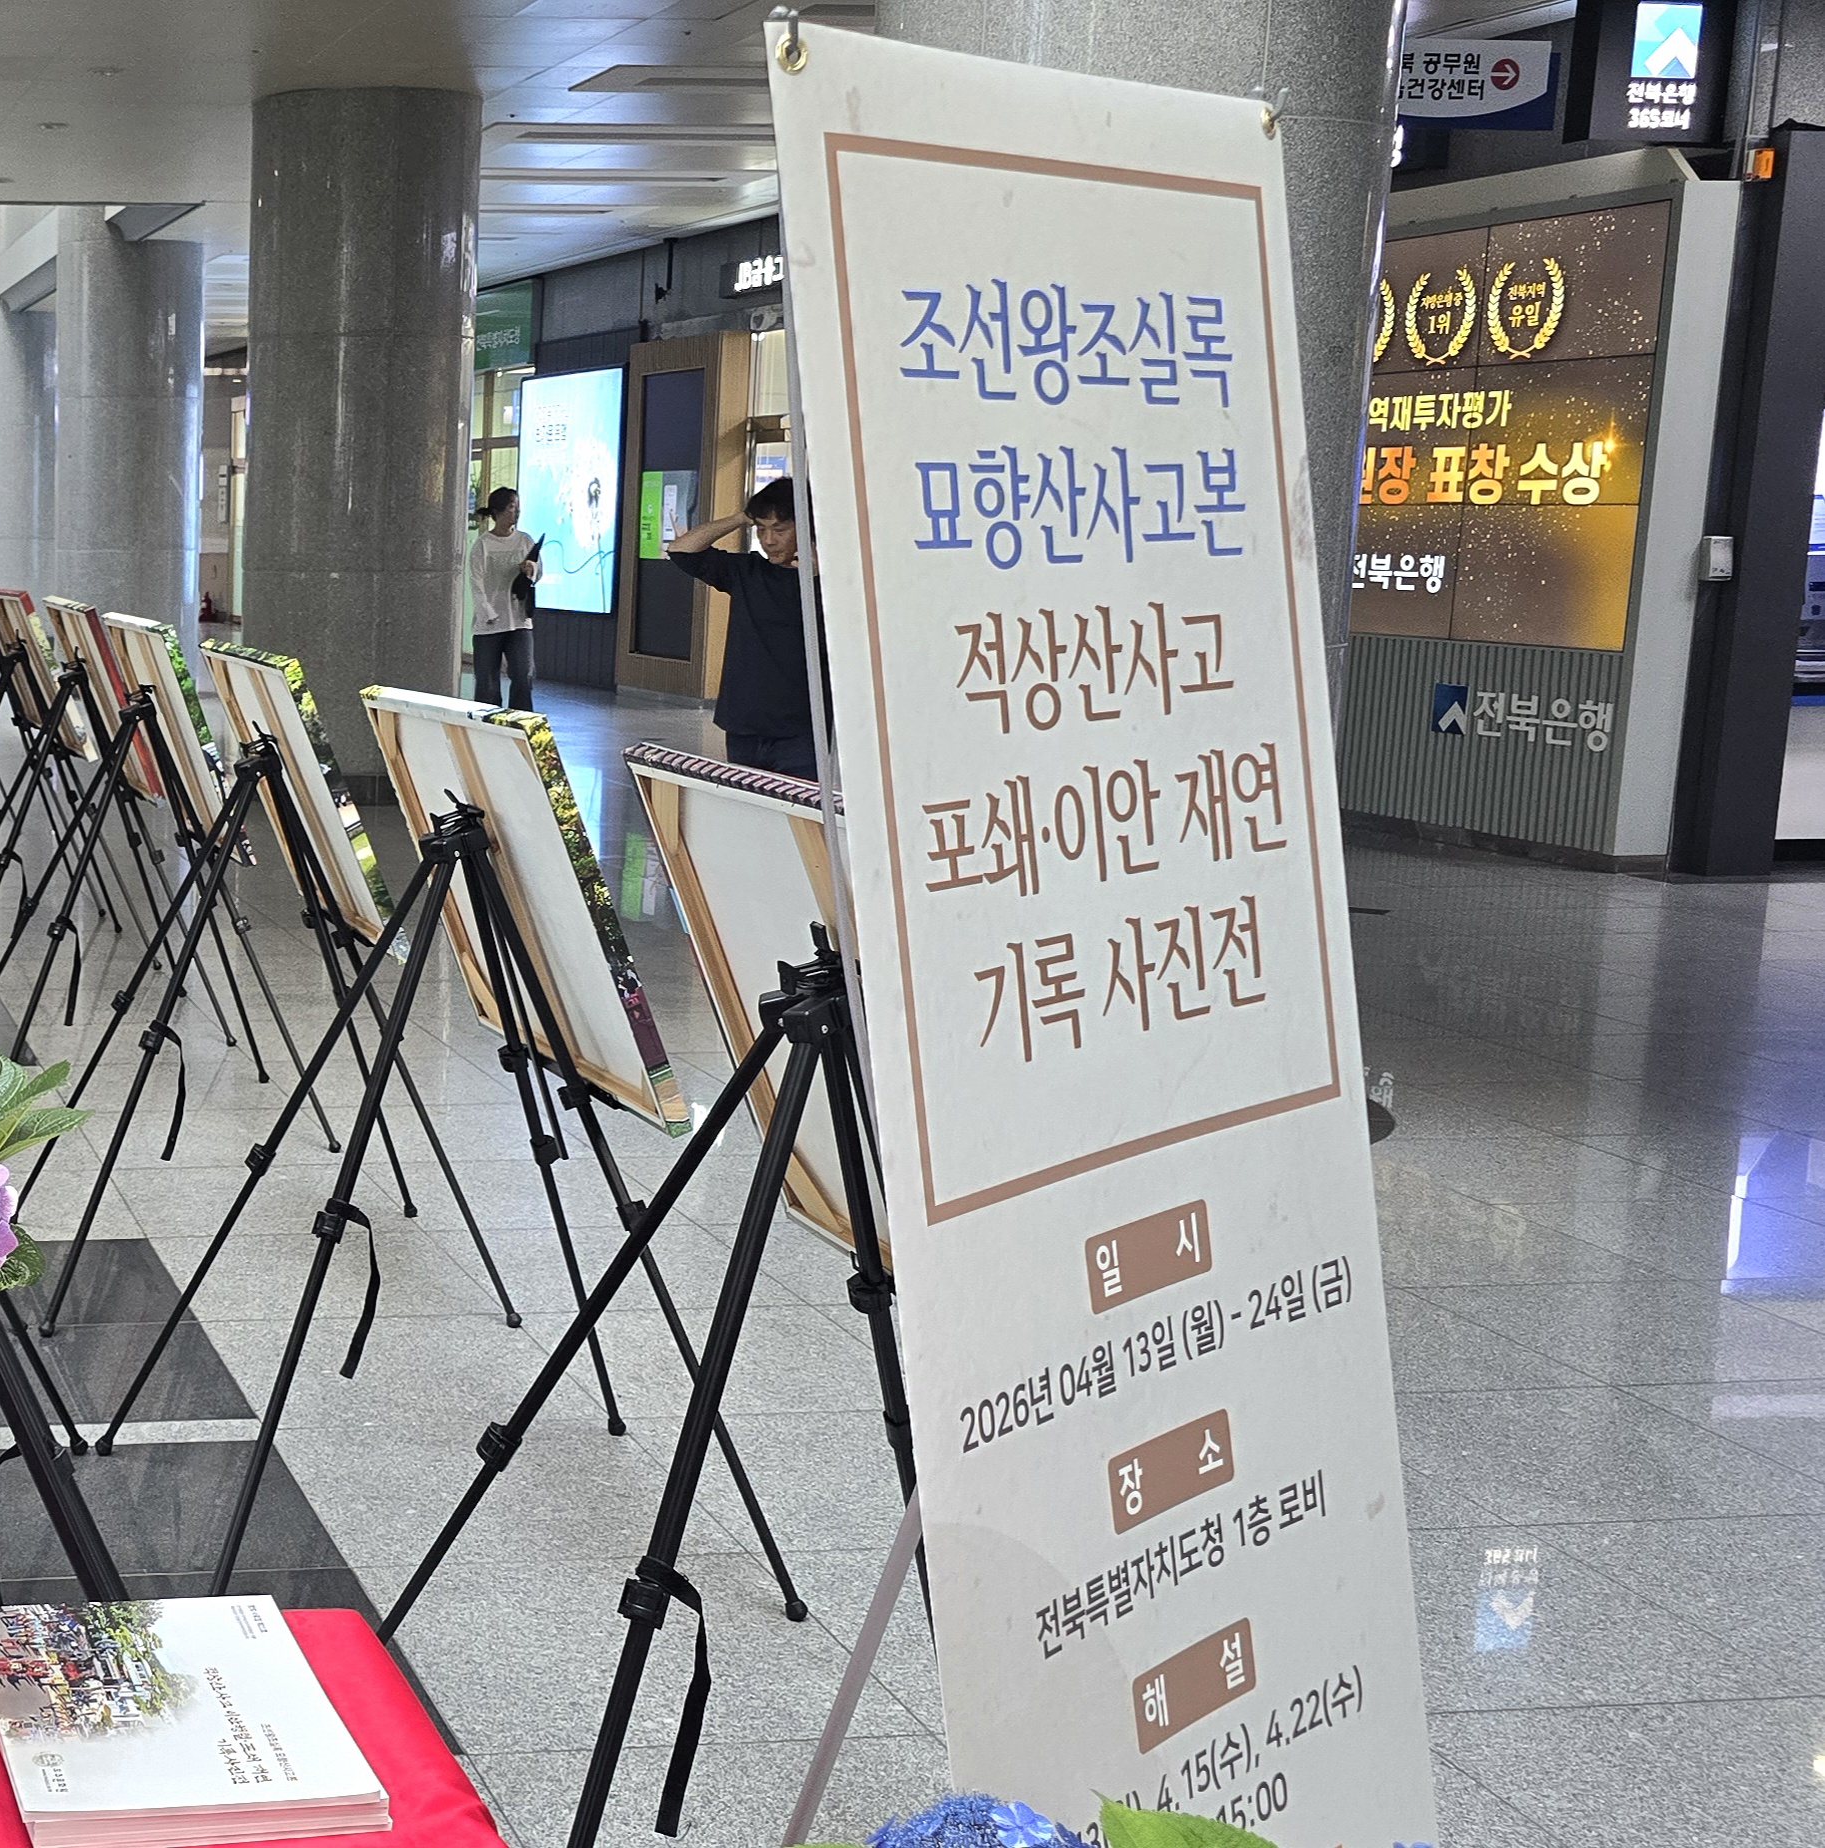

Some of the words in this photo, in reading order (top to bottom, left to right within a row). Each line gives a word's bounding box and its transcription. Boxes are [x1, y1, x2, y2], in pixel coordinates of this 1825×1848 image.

[1423, 52, 1481, 76] 공무원
[1626, 82, 1696, 106] 전북은행
[1628, 107, 1691, 131] 365코너
[1428, 311, 1452, 334] 1위
[1508, 281, 1547, 300] 전북지역
[1508, 301, 1542, 328] 유일
[900, 277, 1233, 408] 조선왕조실록
[1368, 390, 1513, 432] 역재투자평가
[914, 444, 1246, 570] 묘향산사고본
[1426, 442, 1510, 505] 표창
[1516, 441, 1609, 505] 수상
[1351, 553, 1445, 593] 전북은행
[954, 600, 1235, 734] 적상산사고
[1473, 690, 1614, 752] 전북은행
[921, 758, 1162, 898] 포쇄·이안
[1175, 742, 1288, 862] 재연
[973, 932, 1086, 1063] 기록
[1103, 895, 1267, 1031] 사진전
[1095, 1239, 1123, 1298] 일
[1175, 1212, 1202, 1263] 시
[959, 1366, 1055, 1454] 2026년
[1059, 1340, 1118, 1407] 04월
[1122, 1315, 1178, 1378] 13일
[1181, 1298, 1225, 1361] (월)
[1247, 1269, 1307, 1331] 24일
[1311, 1255, 1353, 1314] (금)
[1117, 1458, 1144, 1516] 장
[1197, 1429, 1225, 1476] 소
[1034, 1512, 1226, 1661] 전북특별자치도청
[1232, 1494, 1272, 1549] 1층
[1278, 1469, 1328, 1530] 로비
[1140, 1673, 1169, 1728] 해
[1218, 1631, 1247, 1691] 설
[1265, 1664, 1364, 1751] 4.22(수)
